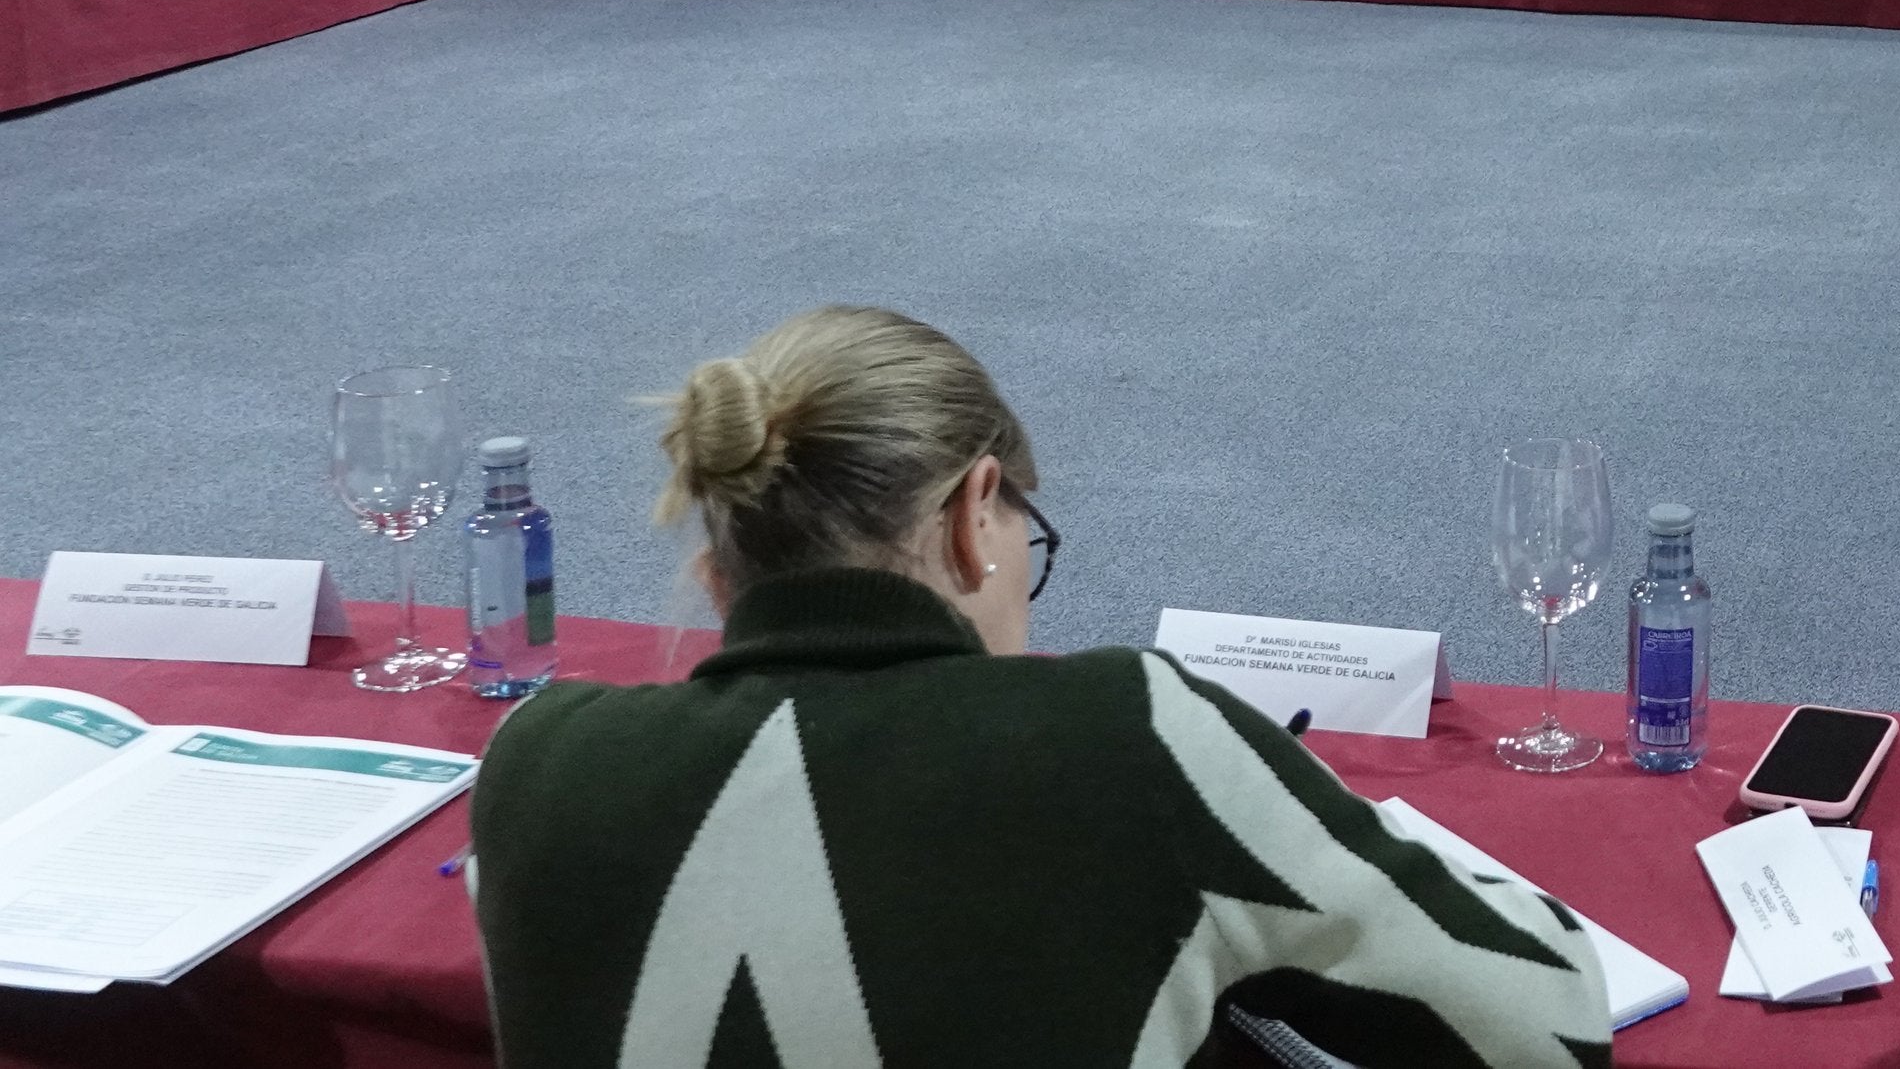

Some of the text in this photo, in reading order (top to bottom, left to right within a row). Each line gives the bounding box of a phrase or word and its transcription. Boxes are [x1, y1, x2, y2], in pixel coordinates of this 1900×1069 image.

[1215, 644, 1369, 666] DEPARTAMENTO DE ACTIVIDADES
[1299, 640, 1342, 651] IGLESIAS
[1184, 654, 1396, 681] FUNDACION SEMANA VERDE DE GALICIA
[1762, 865, 1784, 895] CACHEDA
